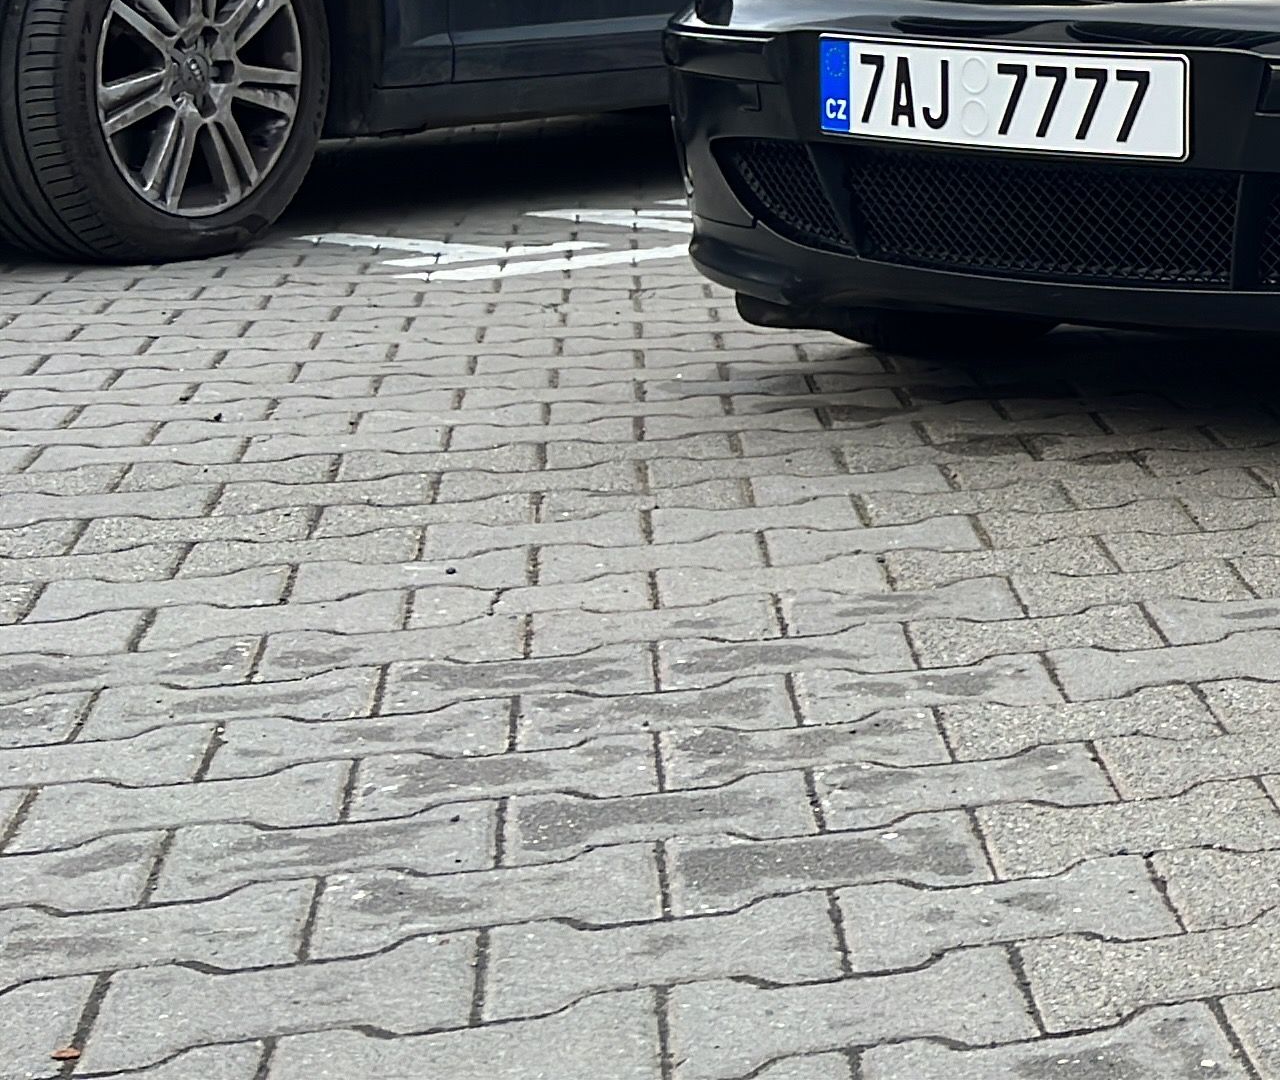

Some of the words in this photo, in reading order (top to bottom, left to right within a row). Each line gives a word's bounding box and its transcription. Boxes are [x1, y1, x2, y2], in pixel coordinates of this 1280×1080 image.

[825, 98, 847, 120] CZ
[860, 53, 949, 129] 7AJ
[997, 62, 1150, 142] 7777
